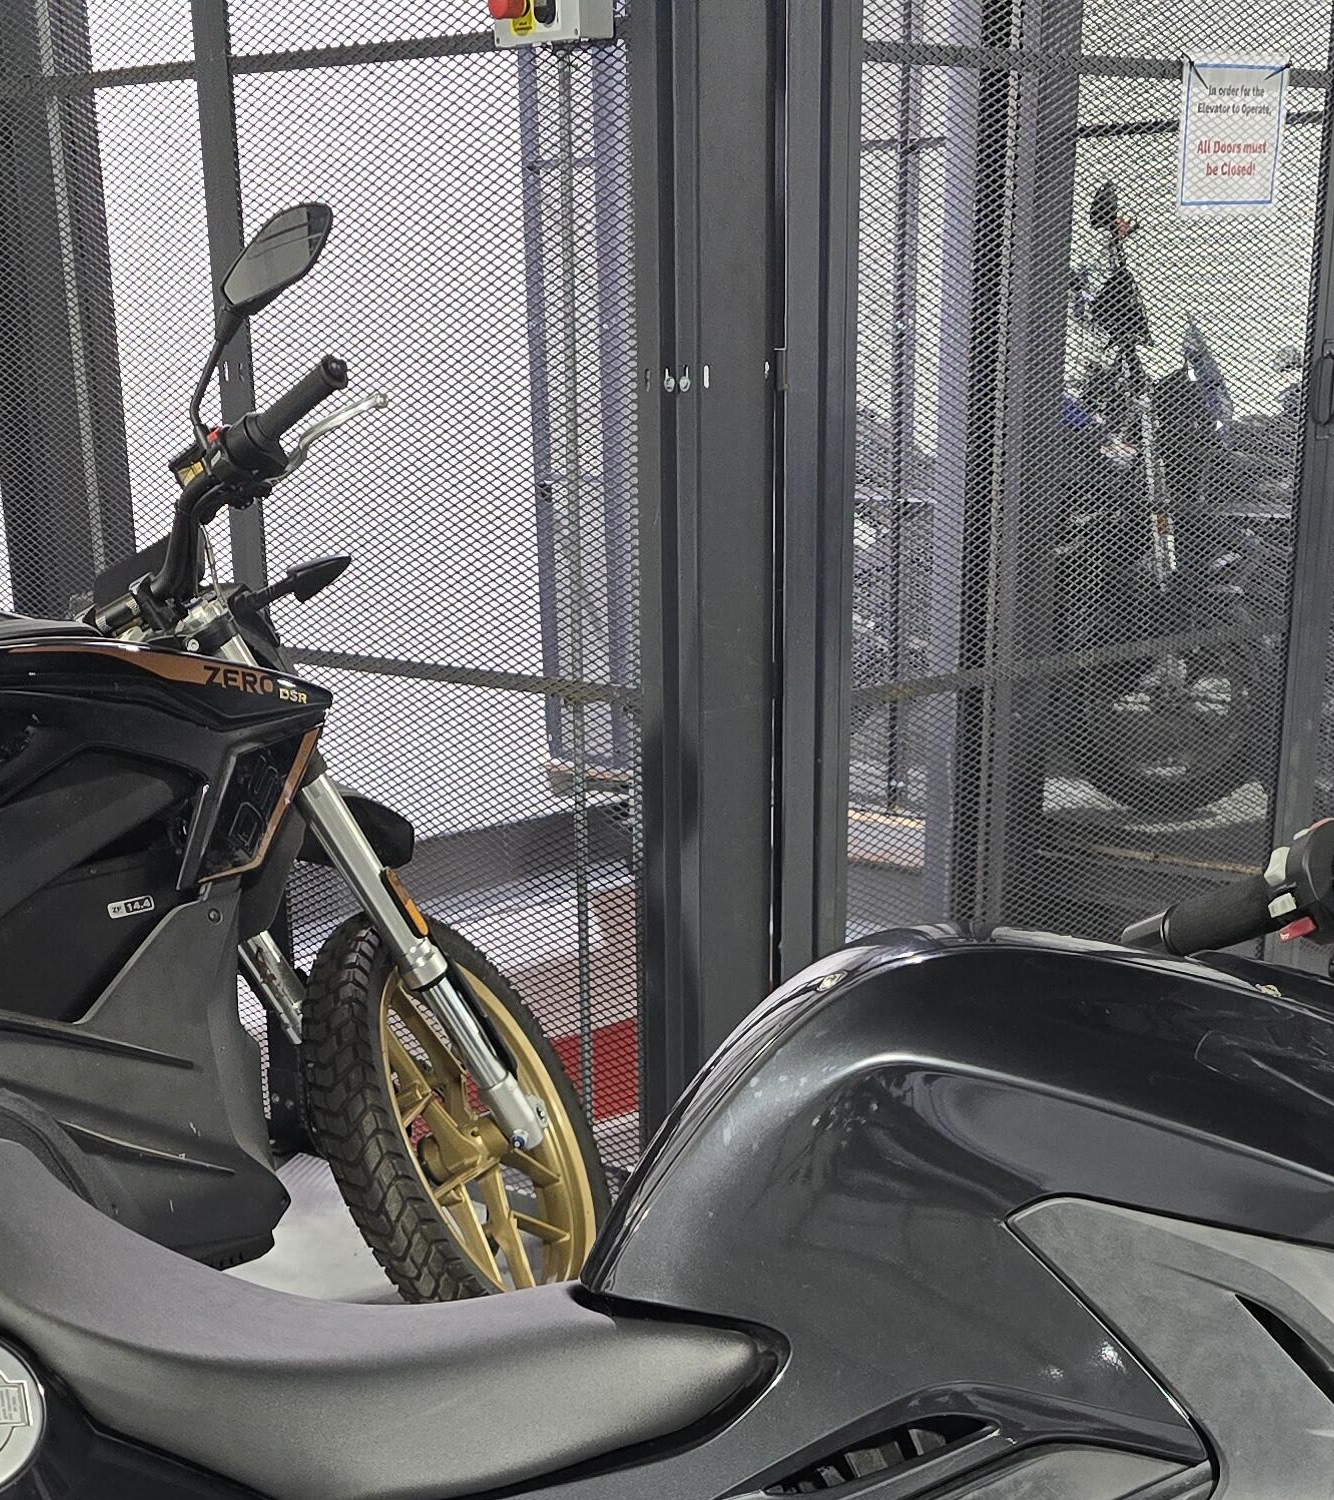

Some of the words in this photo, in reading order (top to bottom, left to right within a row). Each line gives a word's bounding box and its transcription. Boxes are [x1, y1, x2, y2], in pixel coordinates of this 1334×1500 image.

[1208, 85, 1217, 96] In
[1219, 86, 1240, 98] order
[1240, 86, 1251, 96] for
[1252, 86, 1265, 97] the
[1197, 102, 1230, 114] Elevator
[1231, 103, 1240, 115] to
[1197, 140, 1210, 154] All
[1213, 140, 1241, 154] Doors
[1243, 142, 1267, 154] must
[1206, 163, 1218, 176] be
[1221, 162, 1256, 177] Closed!
[203, 665, 274, 696] ZERO
[279, 687, 307, 704] DSR
[127, 898, 151, 912] 14.4
